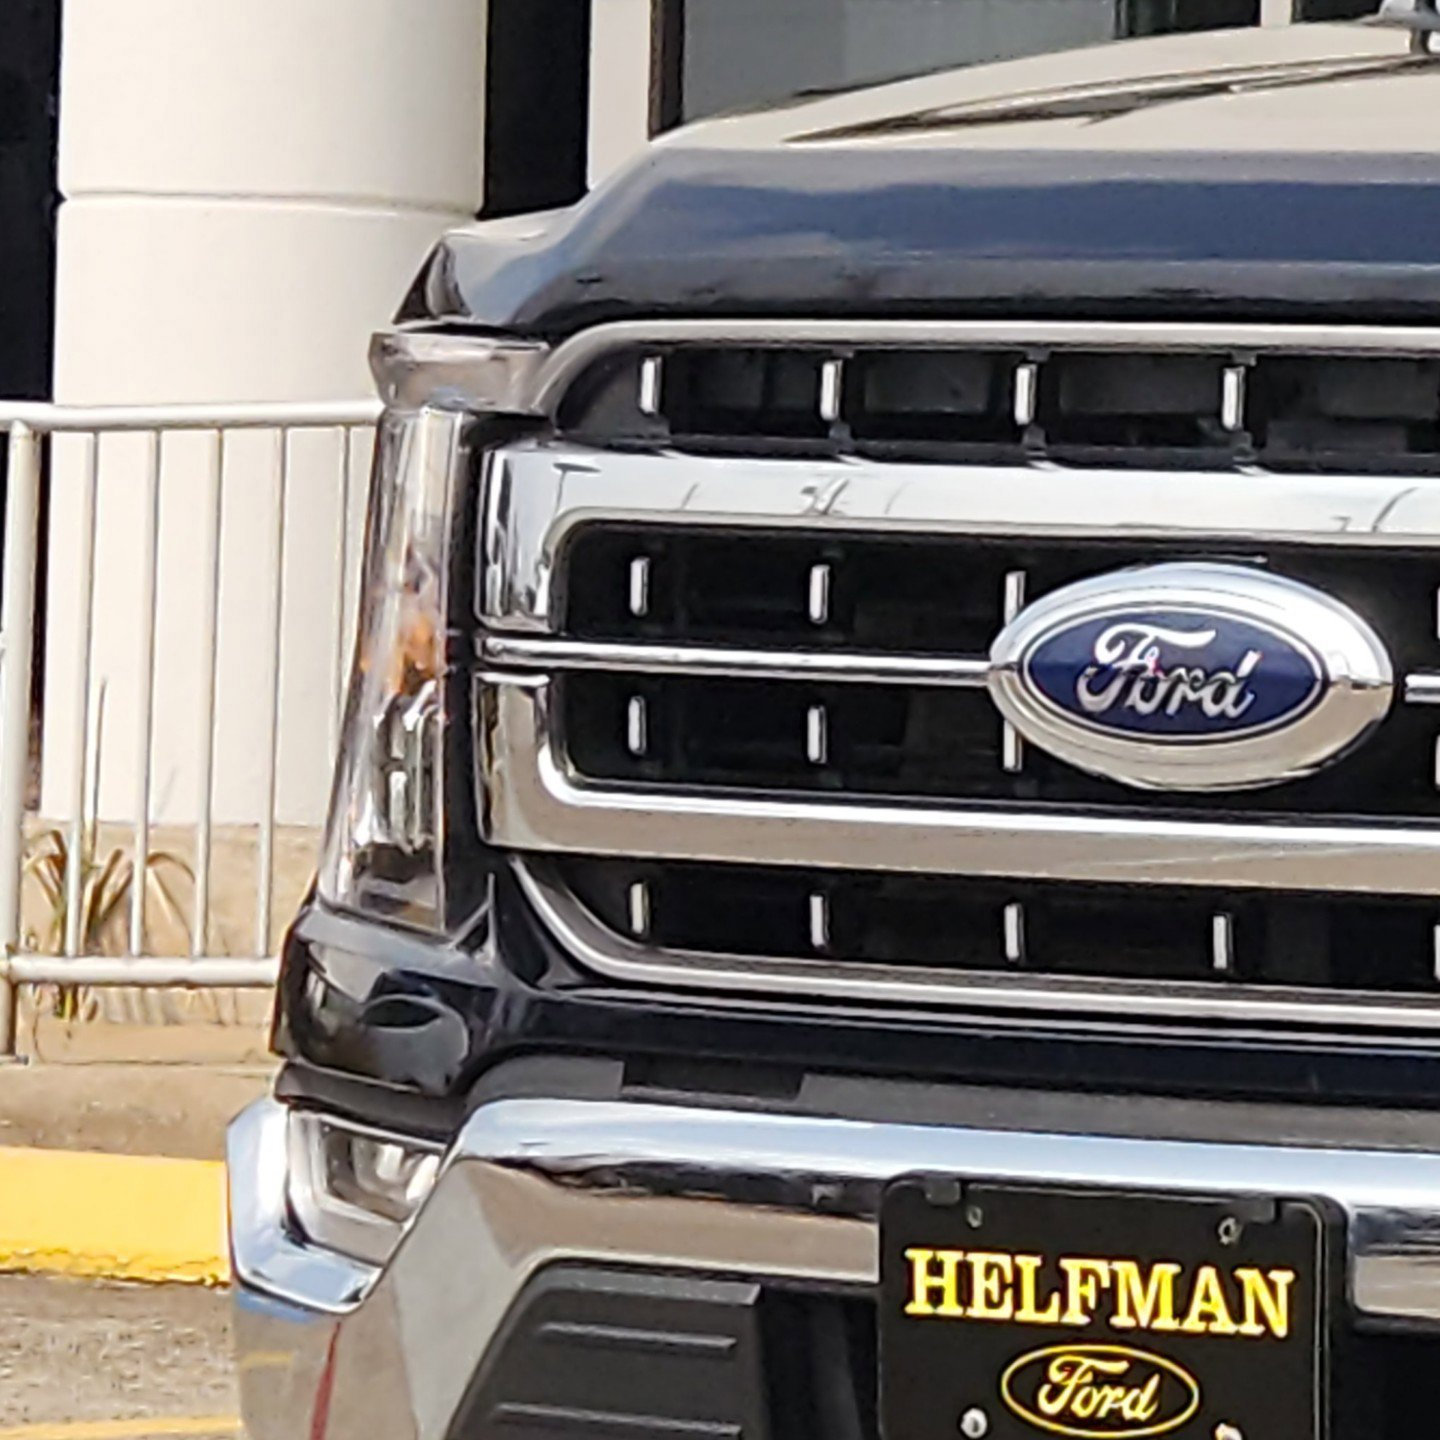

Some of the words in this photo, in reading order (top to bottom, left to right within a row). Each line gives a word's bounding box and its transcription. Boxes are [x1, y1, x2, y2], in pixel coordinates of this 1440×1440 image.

[1077, 623, 1261, 718] Ford
[904, 1248, 1295, 1338] HELFMAN
[1037, 1355, 1161, 1421] Ford
